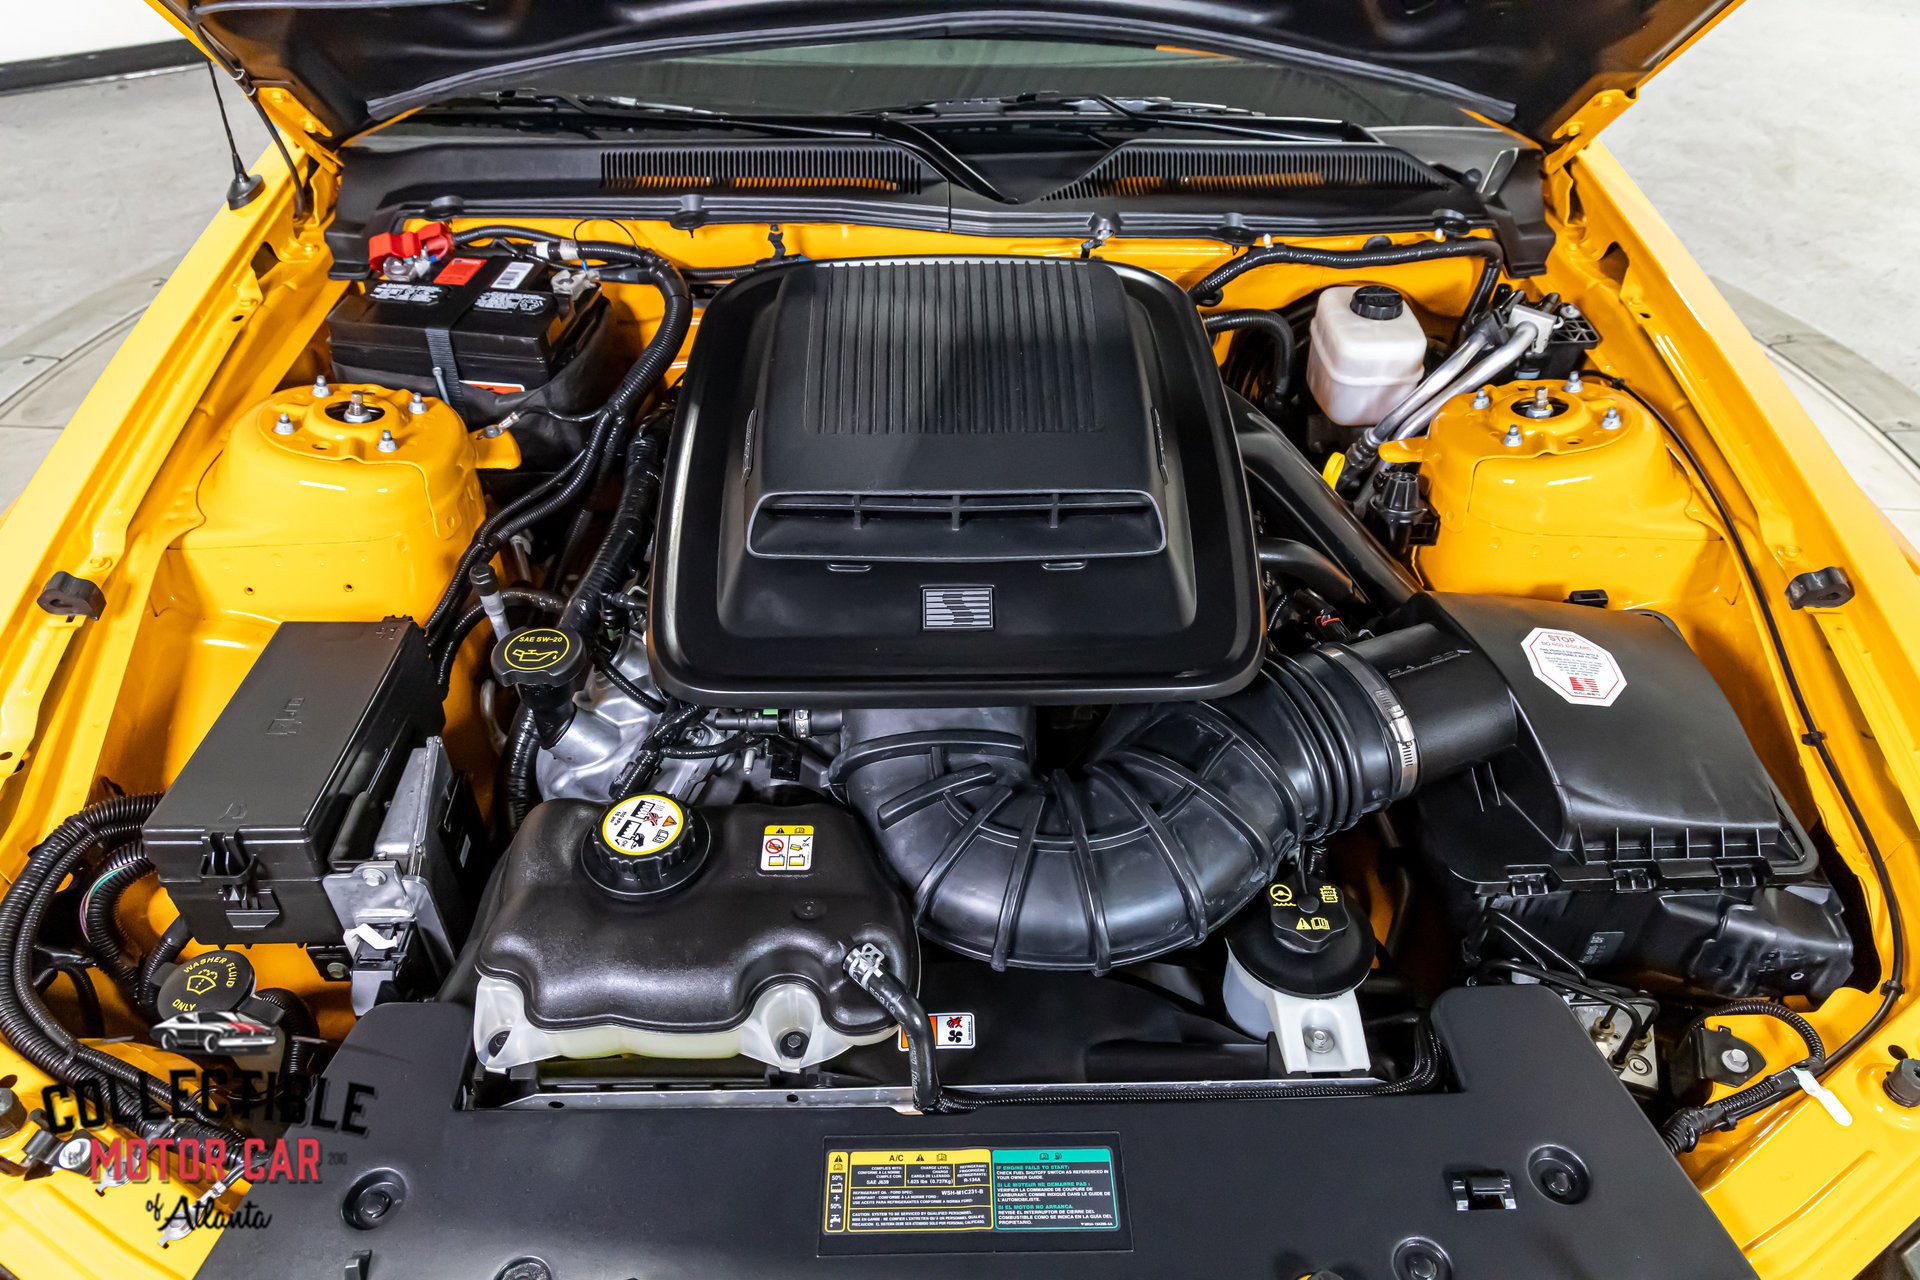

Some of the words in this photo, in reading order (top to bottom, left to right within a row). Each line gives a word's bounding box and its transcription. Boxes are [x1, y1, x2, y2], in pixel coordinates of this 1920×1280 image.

[1547, 634, 1575, 643] STOP
[183, 956, 228, 974] WASHER
[225, 962, 237, 988] FLUID
[172, 998, 197, 1012] ONLY
[889, 1154, 904, 1162] A/C
